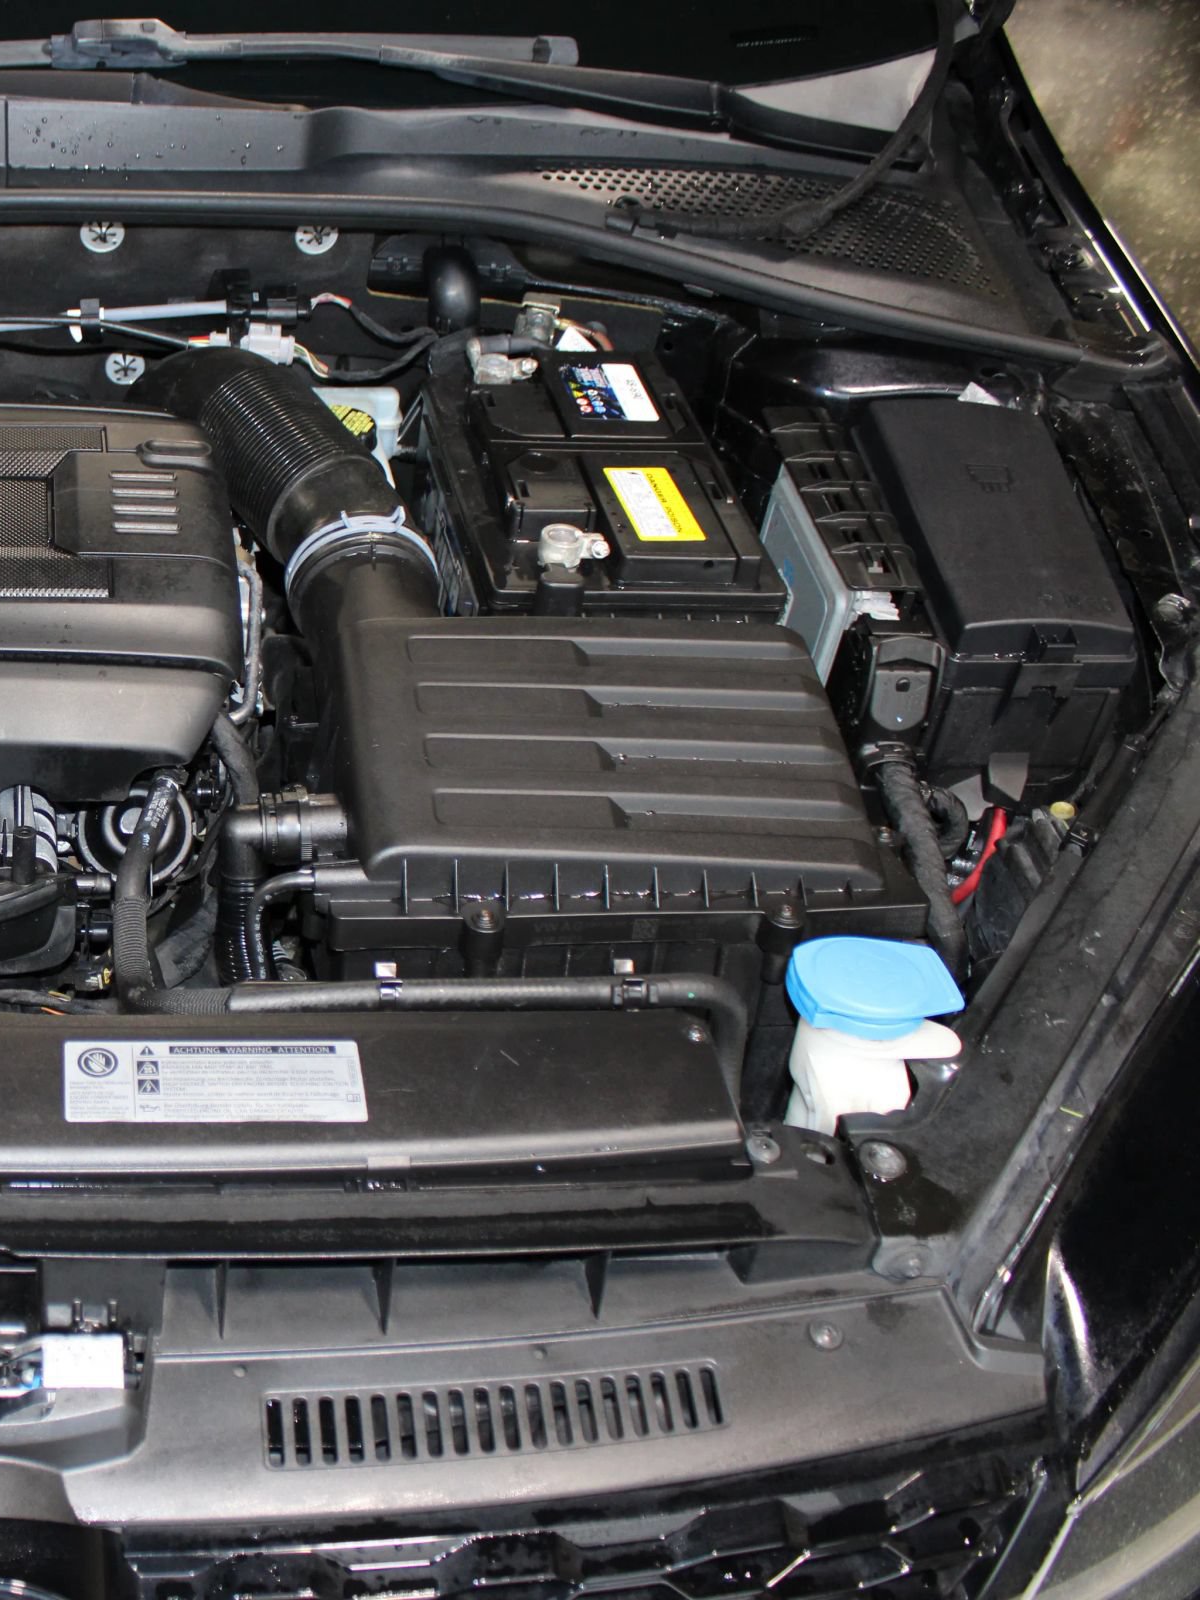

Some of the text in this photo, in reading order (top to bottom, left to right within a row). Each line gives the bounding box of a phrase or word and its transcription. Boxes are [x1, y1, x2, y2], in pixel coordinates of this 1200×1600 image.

[646, 473, 667, 503] DANGER
[173, 1046, 330, 1054] ACHTUNG WARNING ATTENTION
